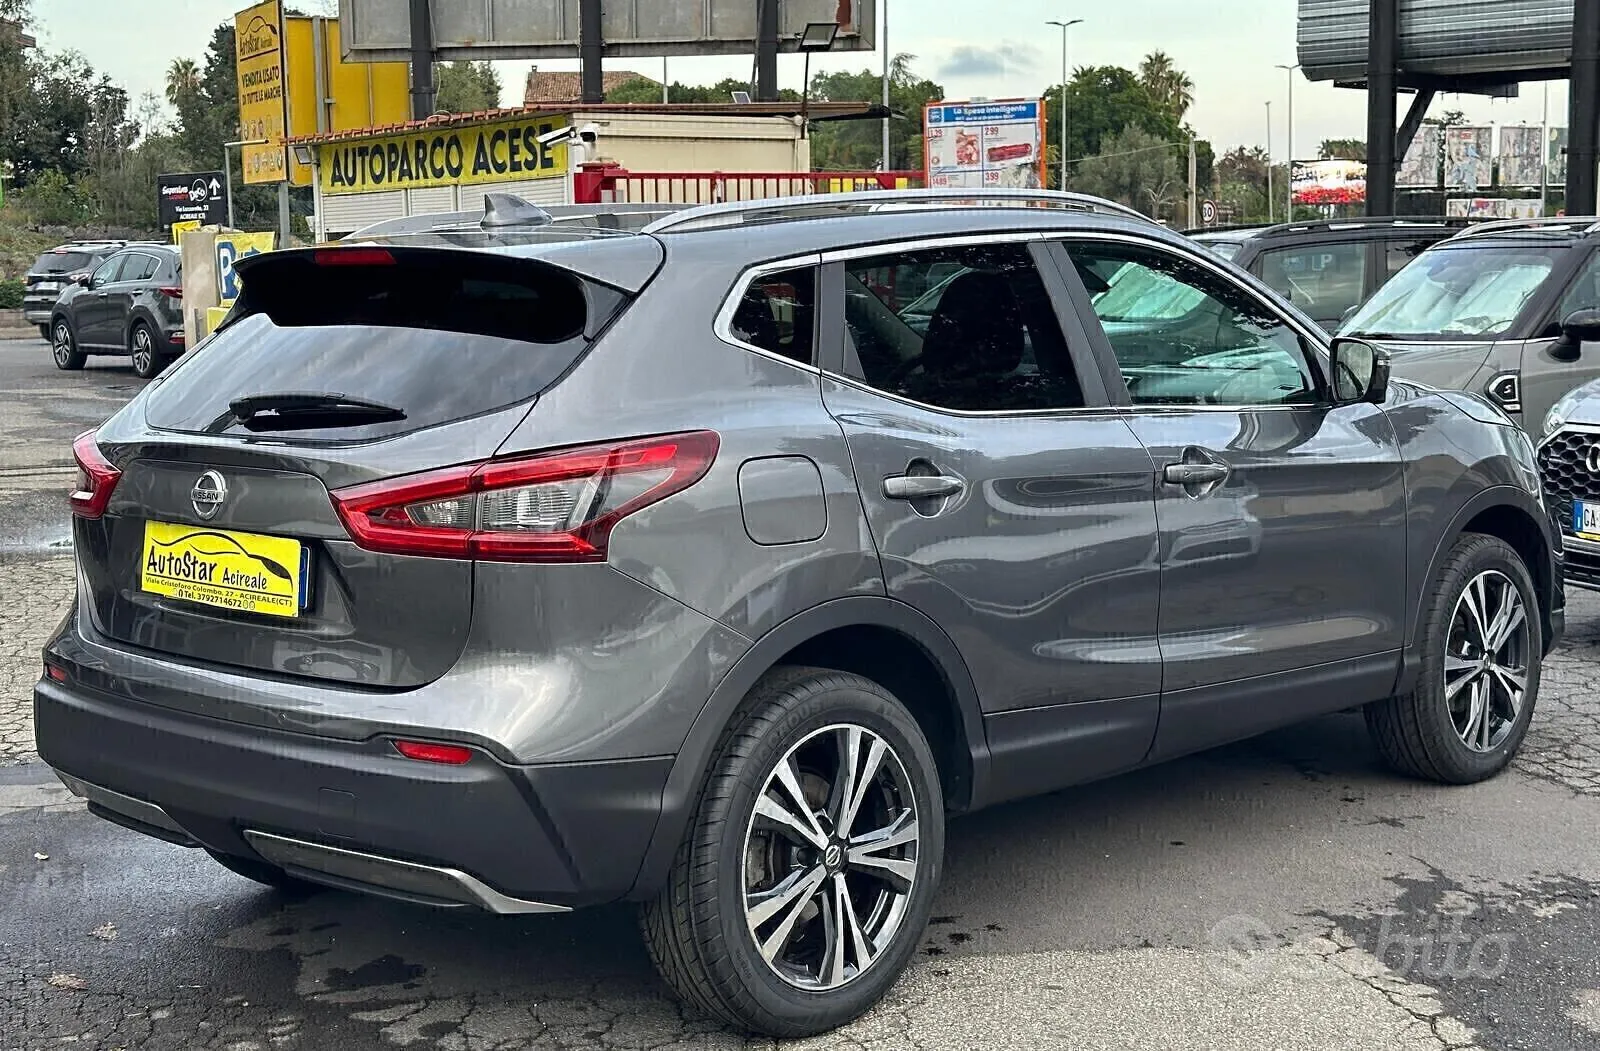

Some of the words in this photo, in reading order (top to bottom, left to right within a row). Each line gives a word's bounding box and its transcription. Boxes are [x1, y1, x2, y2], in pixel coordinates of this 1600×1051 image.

[242, 69, 262, 89] VENDITA
[263, 65, 280, 83] USATO
[242, 93, 247, 105] DI
[247, 90, 258, 104] TUTTE
[258, 89, 263, 101] LE
[264, 85, 281, 100] MARCHE
[331, 134, 463, 187] AUTOPARCO
[472, 123, 554, 176] ACESE
[219, 248, 231, 293] P
[193, 490, 218, 501] NISSAN
[146, 545, 218, 582] AutoStar
[222, 567, 268, 590] Acireale
[145, 576, 160, 585] Viale
[161, 579, 191, 590] Cristoforo
[192, 585, 224, 597] Colombo,
[184, 590, 196, 600] Tel.
